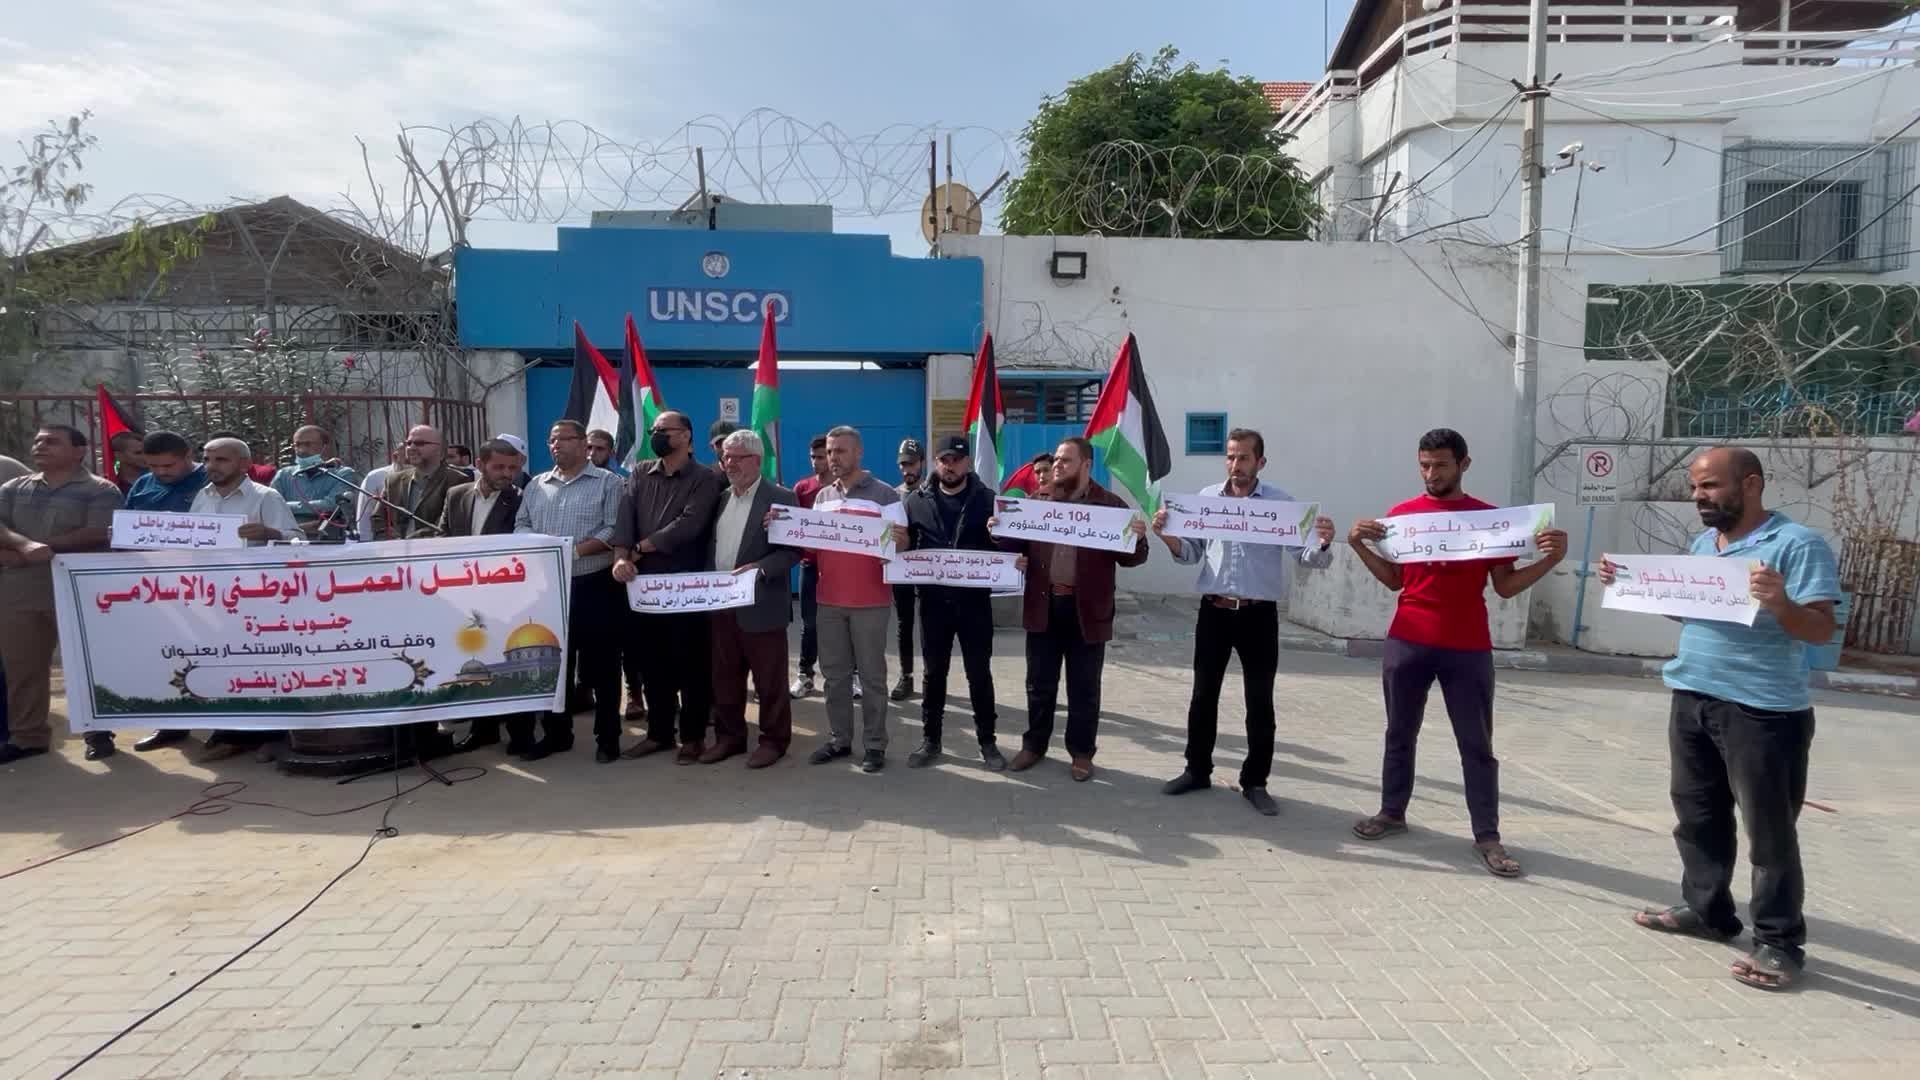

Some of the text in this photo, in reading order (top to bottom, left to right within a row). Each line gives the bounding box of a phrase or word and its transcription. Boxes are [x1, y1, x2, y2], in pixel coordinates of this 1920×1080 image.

[650, 290, 789, 322] UNSCO
[1043, 508, 1091, 522] 104 عام
[1200, 506, 1277, 521] وعد بلفور
[133, 515, 221, 533] وعد بلفور باطل
[800, 518, 863, 534] وعد بلفور
[1008, 519, 1120, 542] مرت على الوعد المشؤوم
[1184, 518, 1297, 536] الوعد المشؤوم
[1402, 519, 1510, 538] وعد بلفور
[194, 537, 217, 547] نحن
[787, 528, 879, 548] الوعد المشؤوم
[1391, 539, 1526, 559] سرقة وطن
[935, 554, 941, 563] لا
[943, 554, 964, 566] البشر
[986, 557, 1004, 566] كل
[904, 568, 934, 580] فلسطين
[1639, 568, 1726, 590] وعد بلفور
[96, 556, 527, 614] فصائل العمل الوطني والإسلامي
[641, 579, 673, 594] باطل
[675, 577, 709, 592] بلفور
[682, 595, 708, 606] كامل
[244, 613, 352, 637] جنوب غزة
[305, 637, 376, 654] الغضب
[381, 634, 436, 650] وقفة
[161, 644, 218, 659] بعنوان
[226, 670, 277, 695] بلفور
[351, 666, 368, 685] لا
